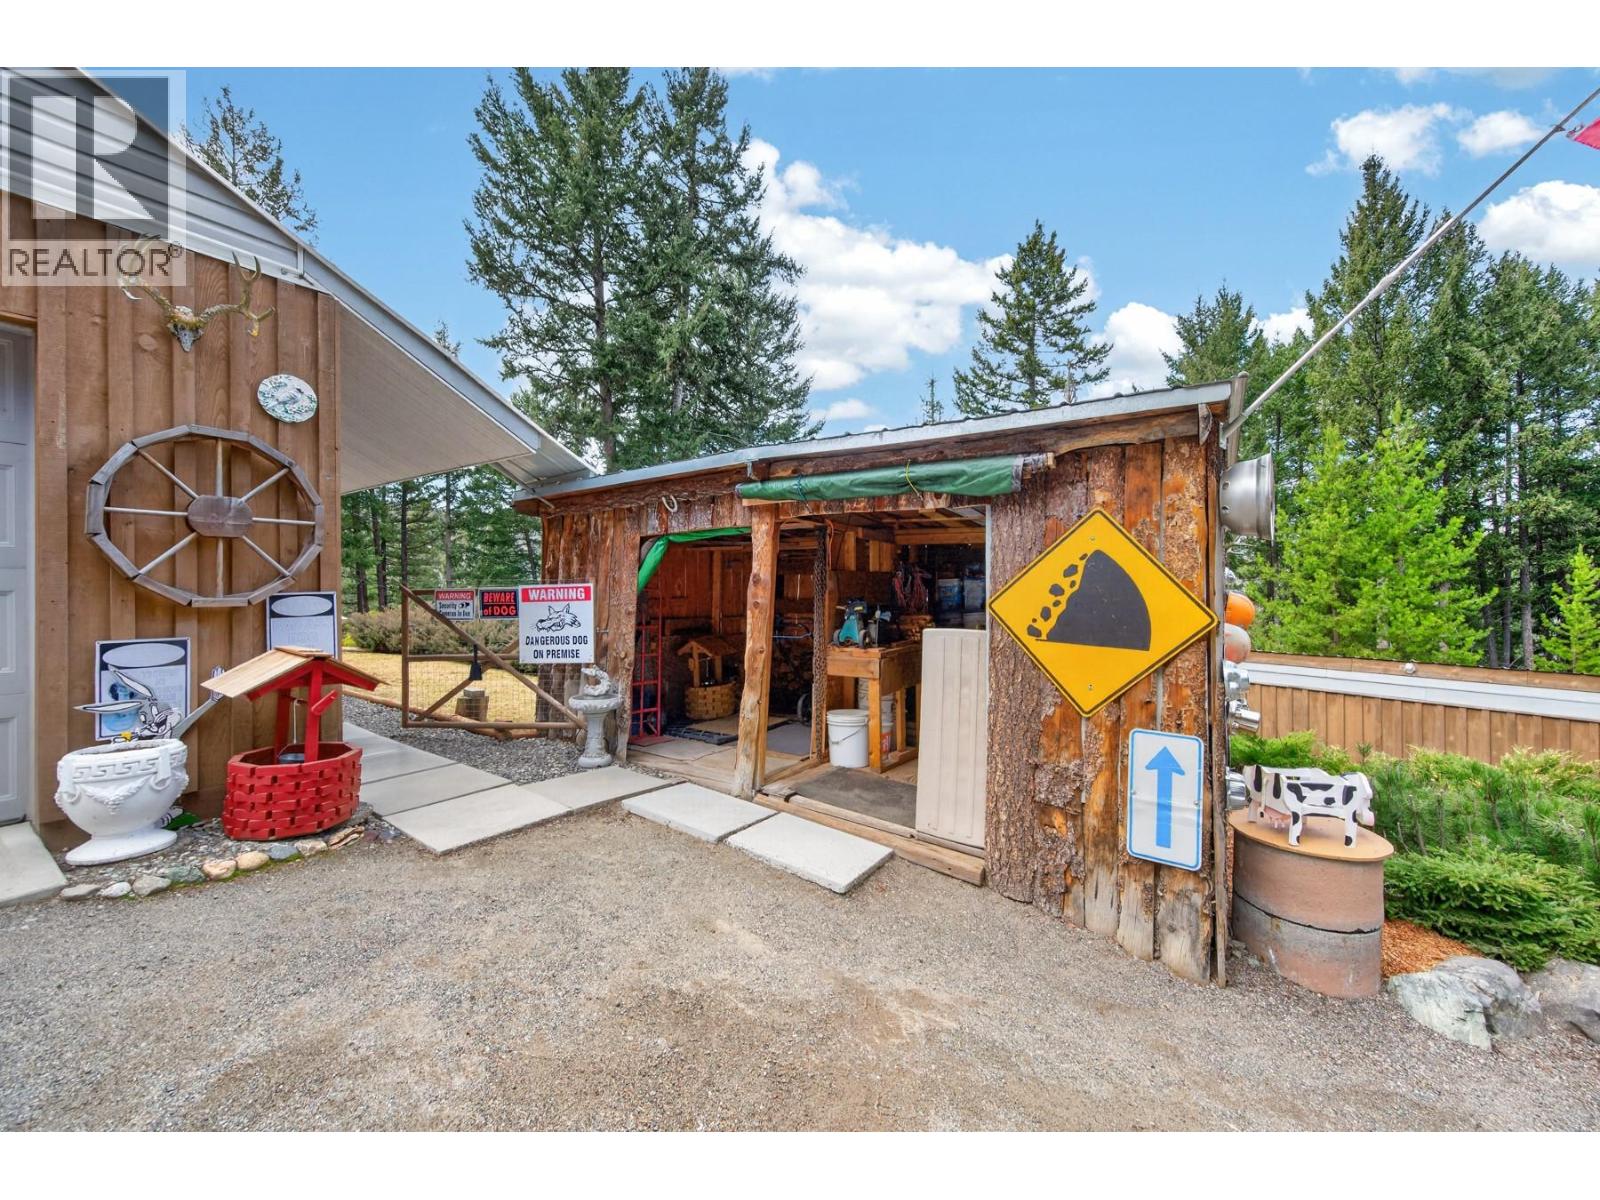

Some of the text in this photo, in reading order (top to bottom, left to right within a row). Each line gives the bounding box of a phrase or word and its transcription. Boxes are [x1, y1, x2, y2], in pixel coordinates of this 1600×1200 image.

[438, 592, 471, 600] WARNING
[483, 592, 515, 603] BEWARE
[528, 588, 586, 601] WARNING
[483, 605, 517, 616] of DOG
[525, 635, 589, 646] DANGEROUS DOG
[533, 649, 580, 660] ON PREMISE
